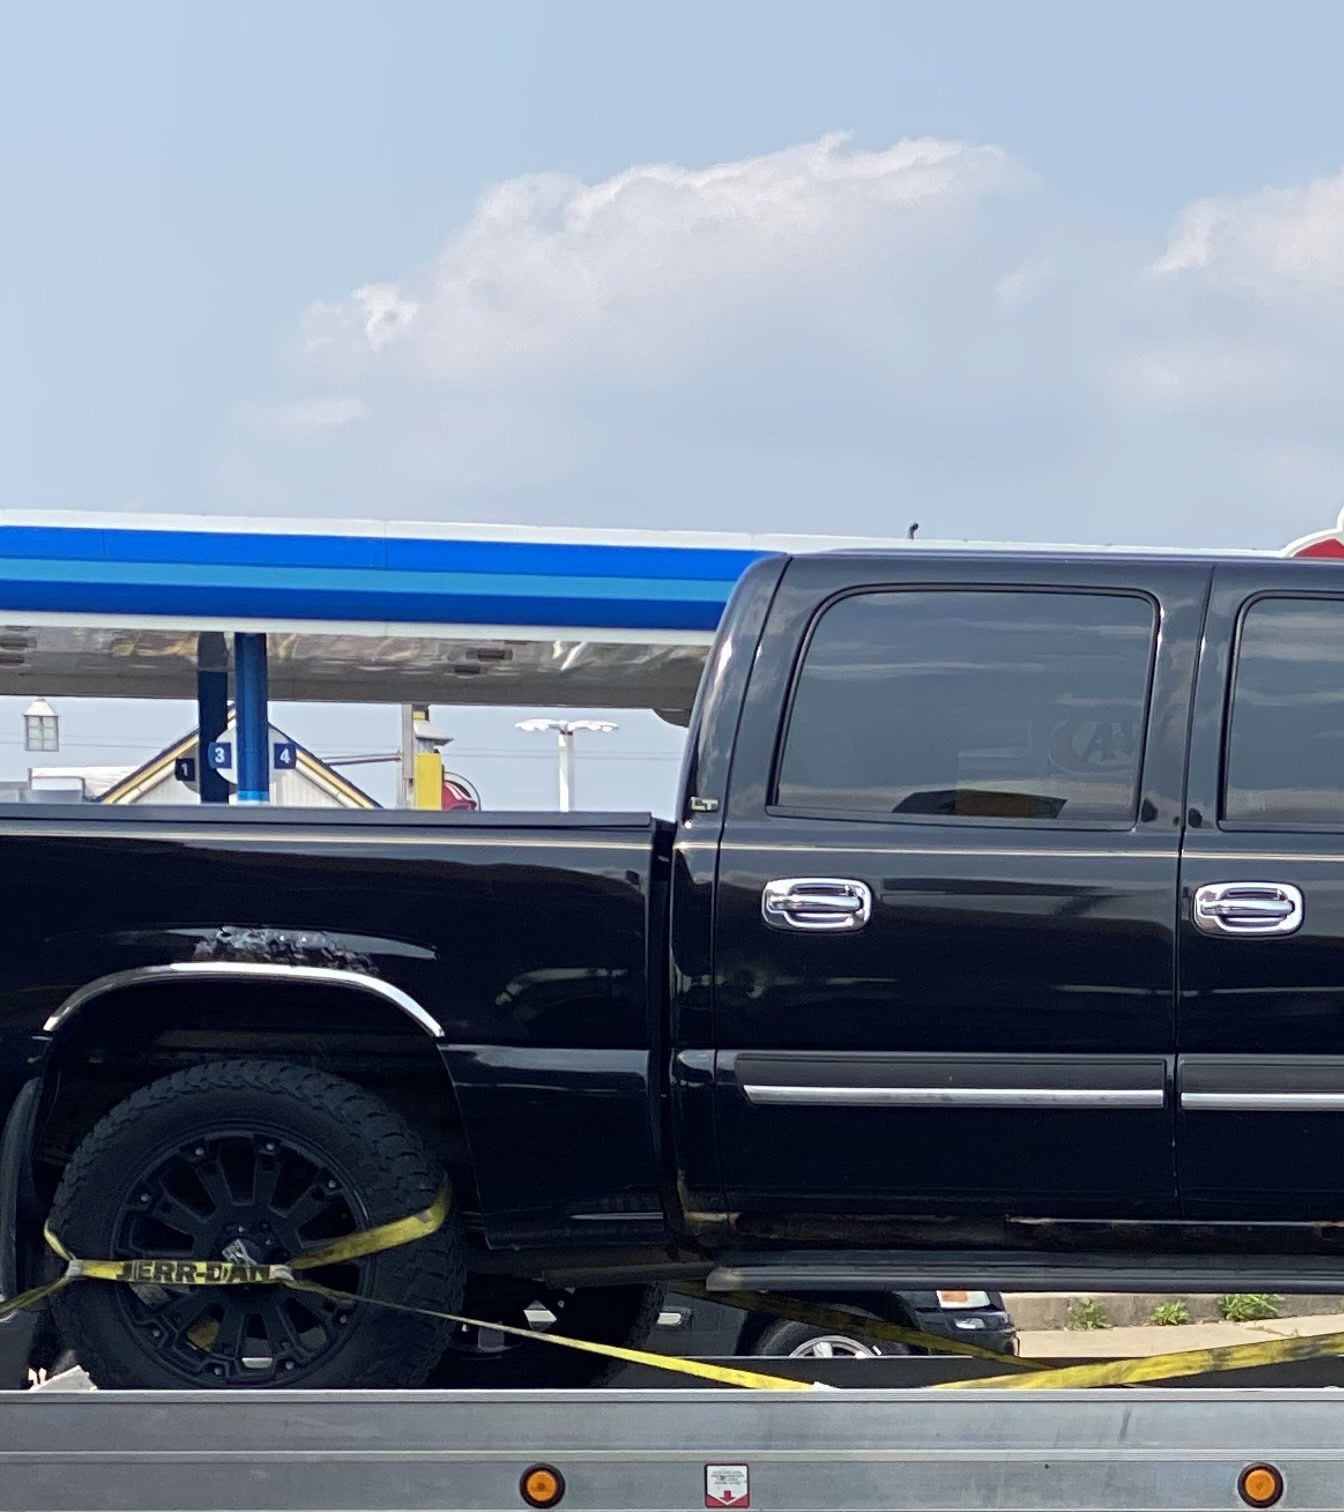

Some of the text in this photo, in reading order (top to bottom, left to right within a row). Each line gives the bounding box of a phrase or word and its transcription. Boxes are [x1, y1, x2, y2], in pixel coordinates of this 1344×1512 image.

[214, 747, 225, 763] 3
[280, 748, 291, 764] 4
[181, 763, 188, 777] 1
[691, 796, 718, 810] LT
[116, 1259, 270, 1284] JERR-DAN
